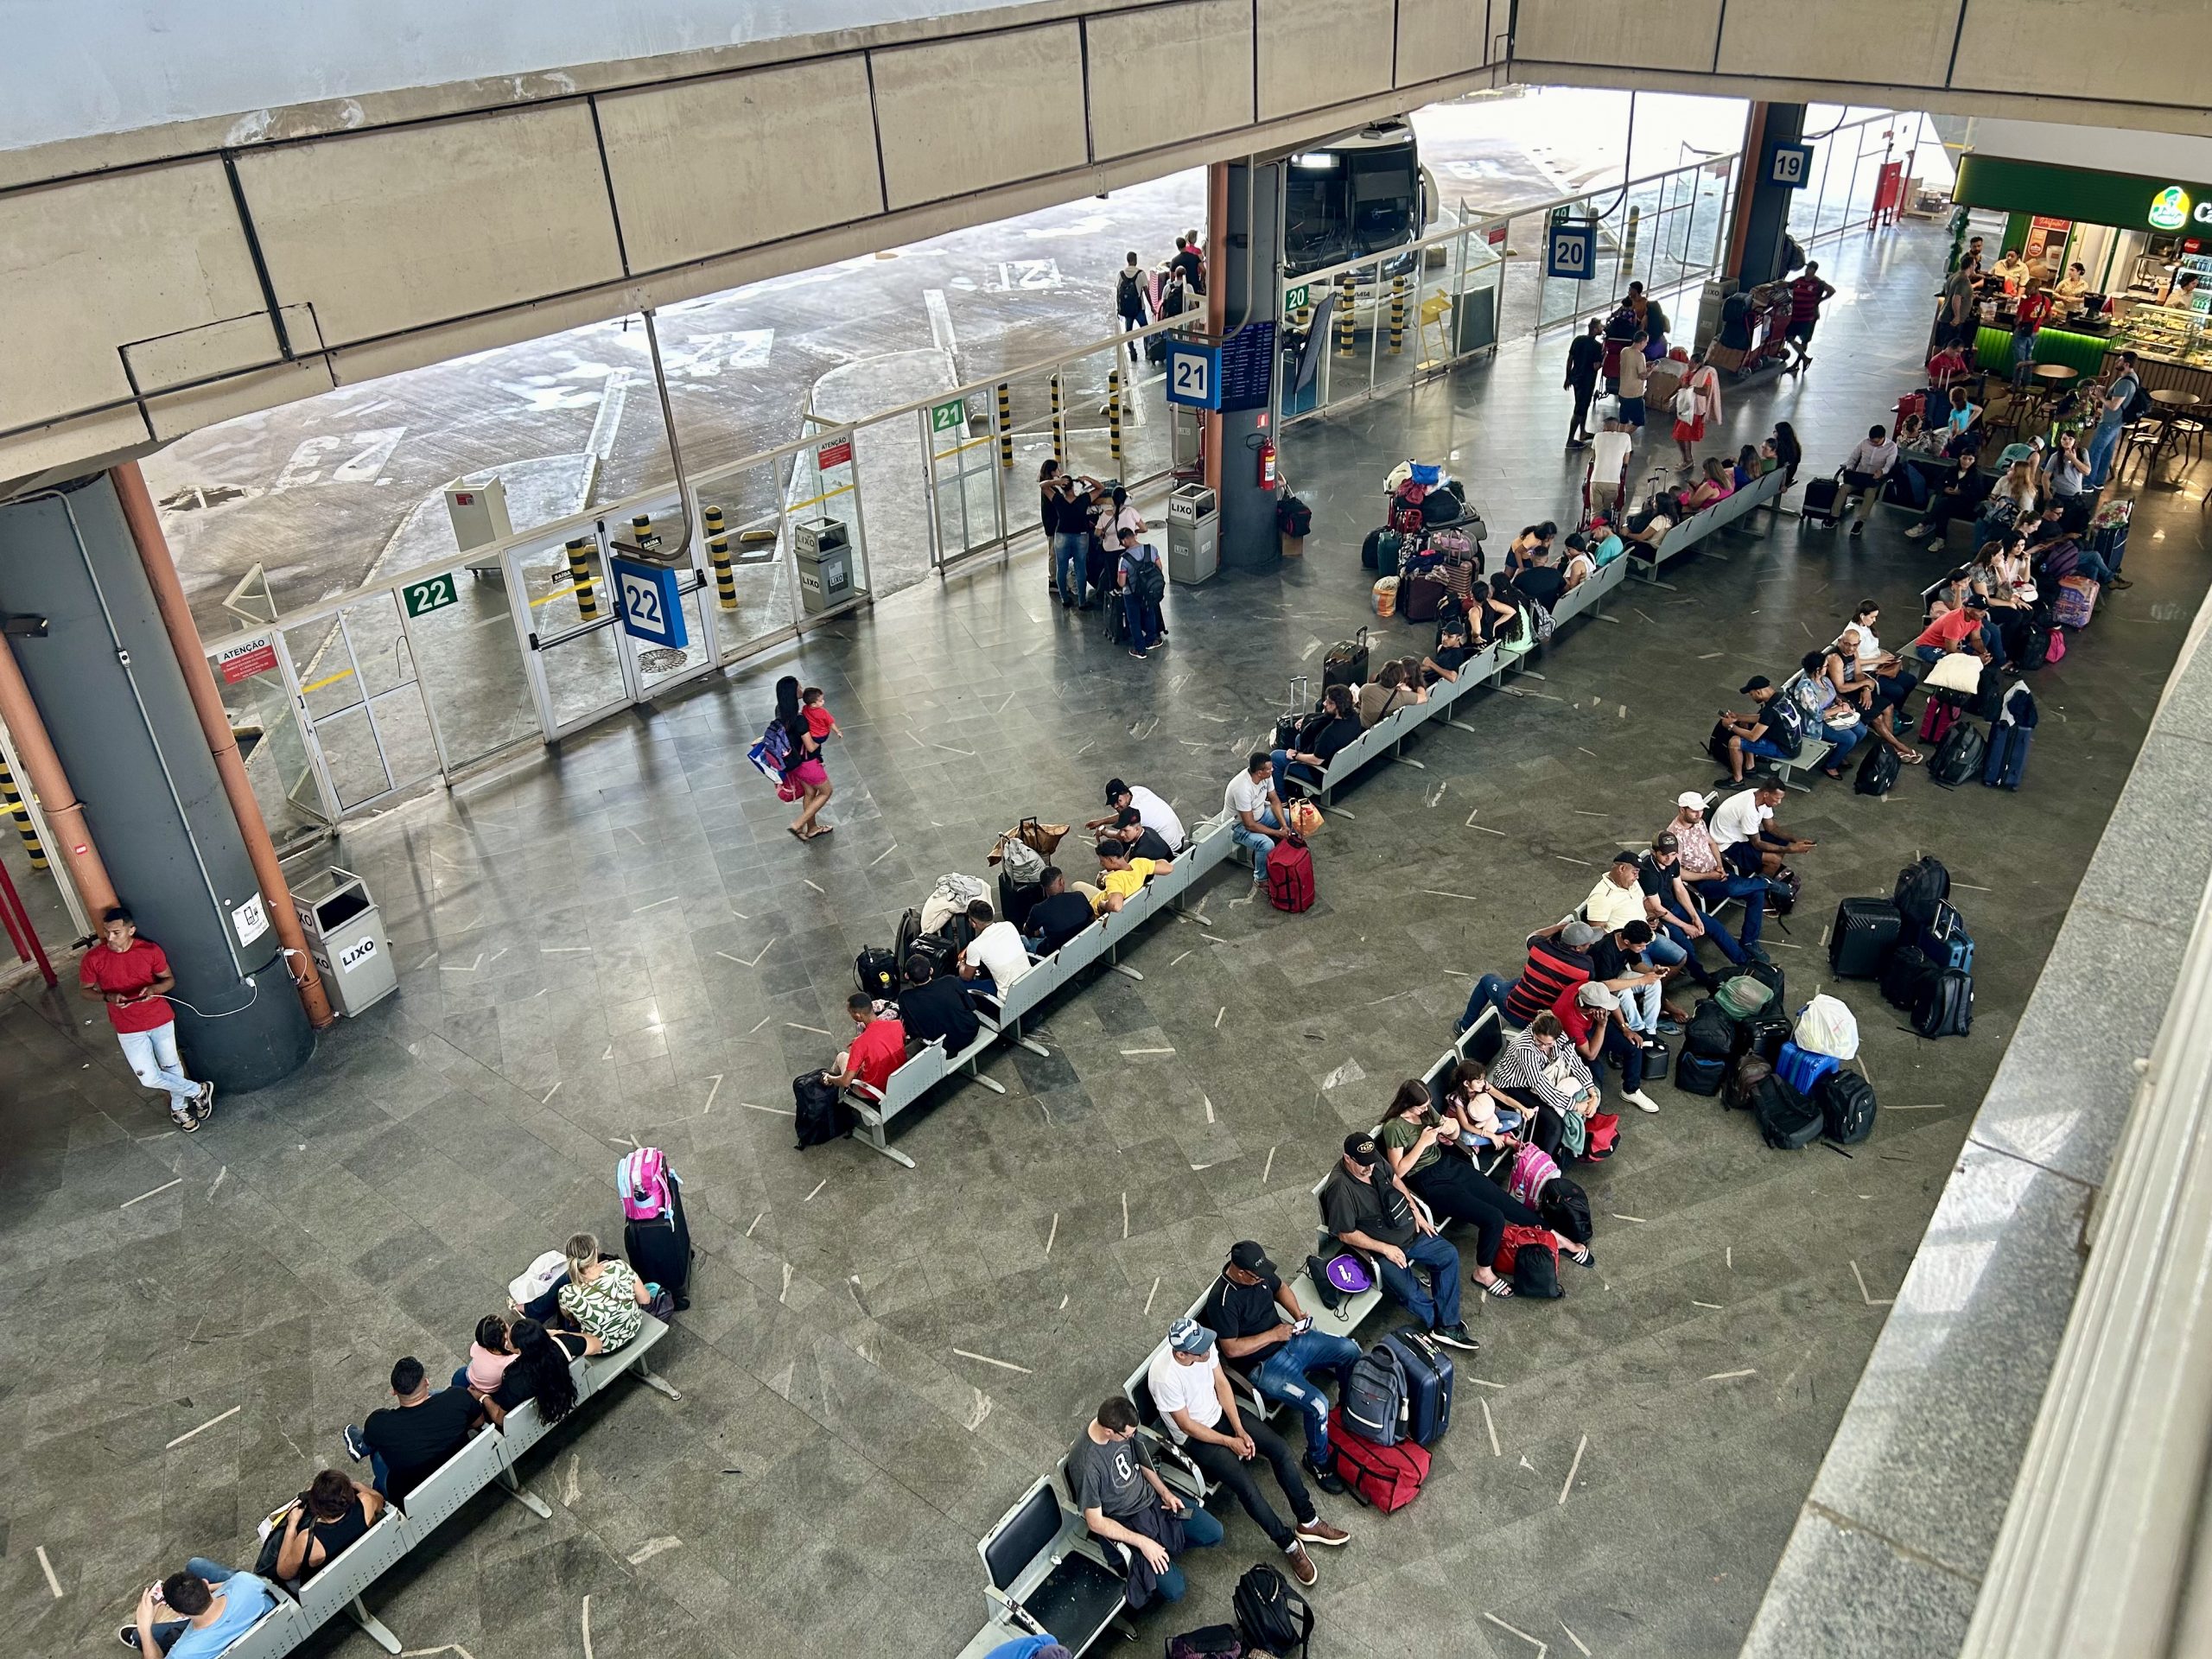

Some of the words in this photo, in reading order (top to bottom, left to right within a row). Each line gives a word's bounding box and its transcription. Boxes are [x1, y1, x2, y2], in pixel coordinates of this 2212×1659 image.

[1777, 156, 1800, 176] 19
[1557, 242, 1583, 264] 20
[1289, 289, 1305, 308] 20
[1178, 361, 1204, 391] 21
[938, 404, 959, 428] 21
[822, 436, 847, 450] ATENÇÃO
[1172, 503, 1192, 516] LIXO
[798, 533, 815, 548] LIXO
[802, 576, 819, 588] LIXO
[830, 575, 843, 586] LIXO
[413, 580, 449, 613] 22
[626, 584, 661, 624] 22
[224, 639, 265, 660] ATENÇÃO
[296, 910, 313, 927] XO
[313, 956, 329, 969] XO
[342, 940, 374, 967] LIXO
